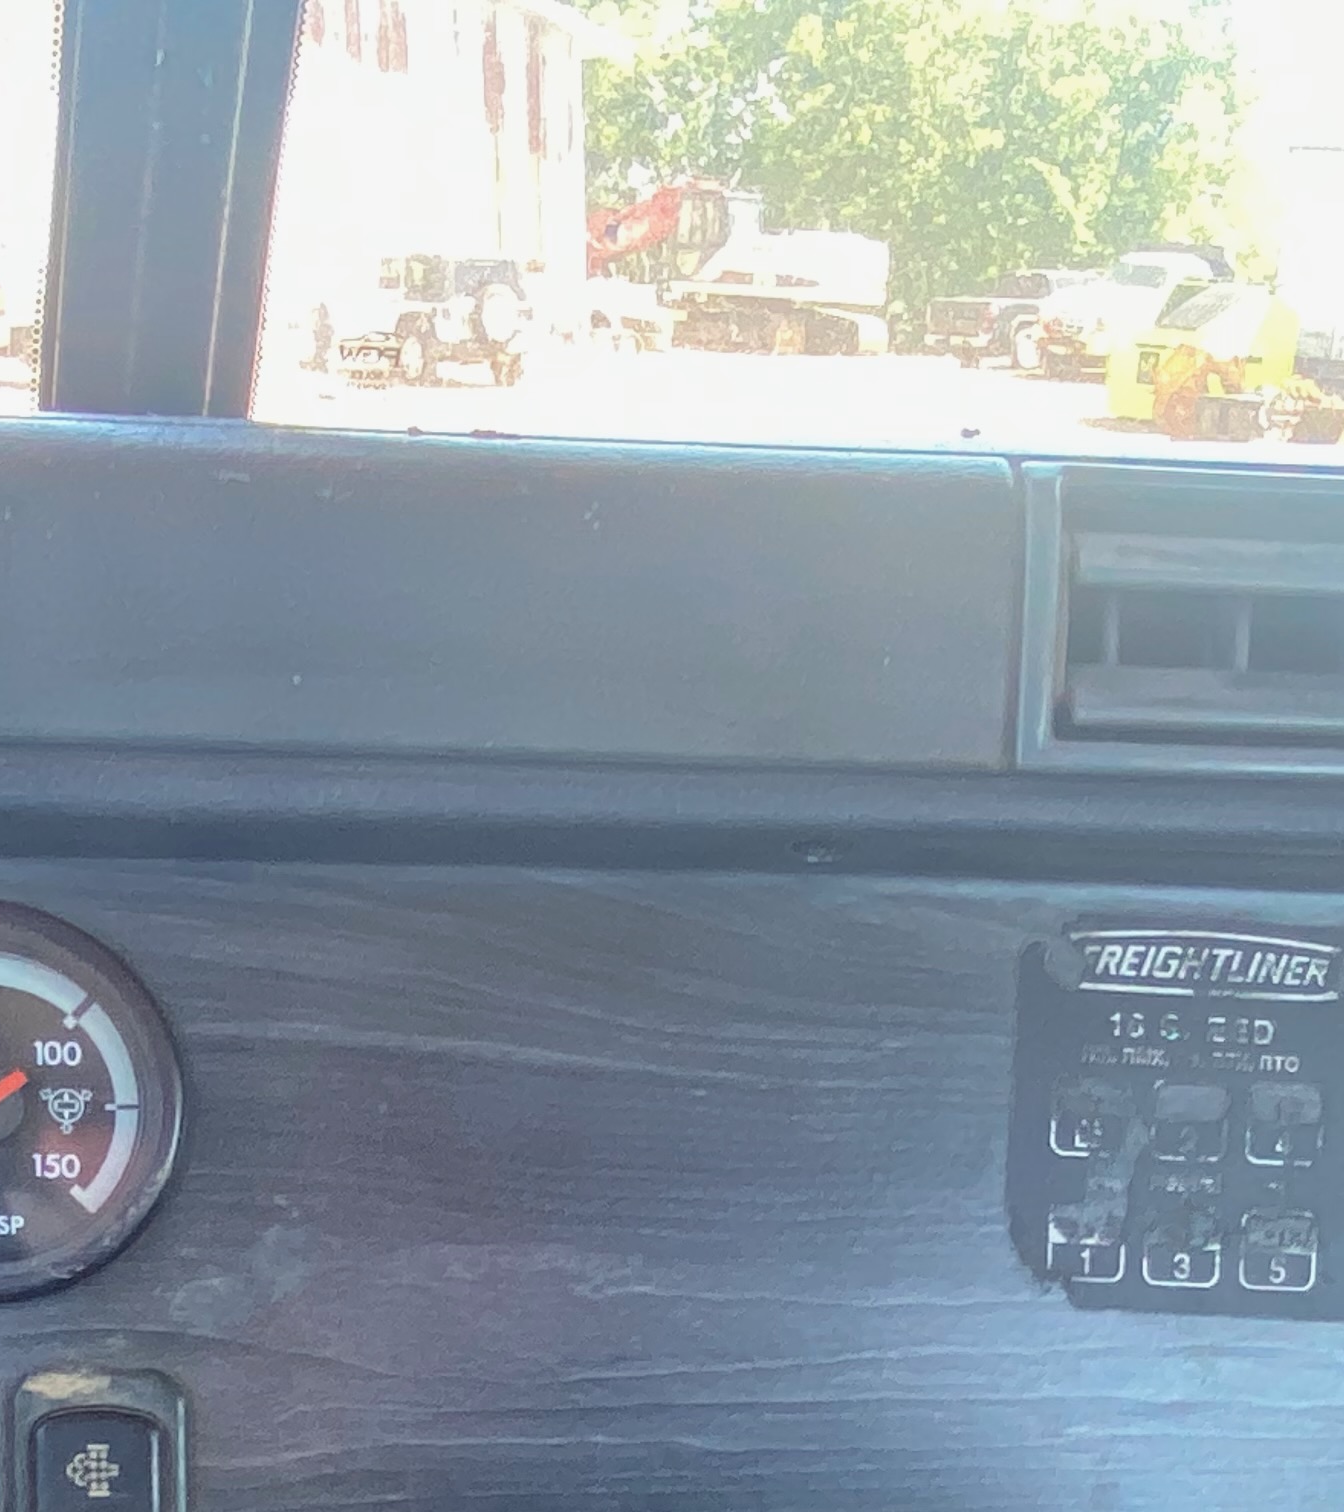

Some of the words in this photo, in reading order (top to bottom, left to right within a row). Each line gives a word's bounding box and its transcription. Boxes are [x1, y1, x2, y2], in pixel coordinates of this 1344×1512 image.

[33, 1041, 82, 1066] 100
[33, 1154, 81, 1178] 150
[1080, 1248, 1090, 1275] 1
[1172, 1253, 1191, 1280] 3
[1269, 1257, 1287, 1284] 5
